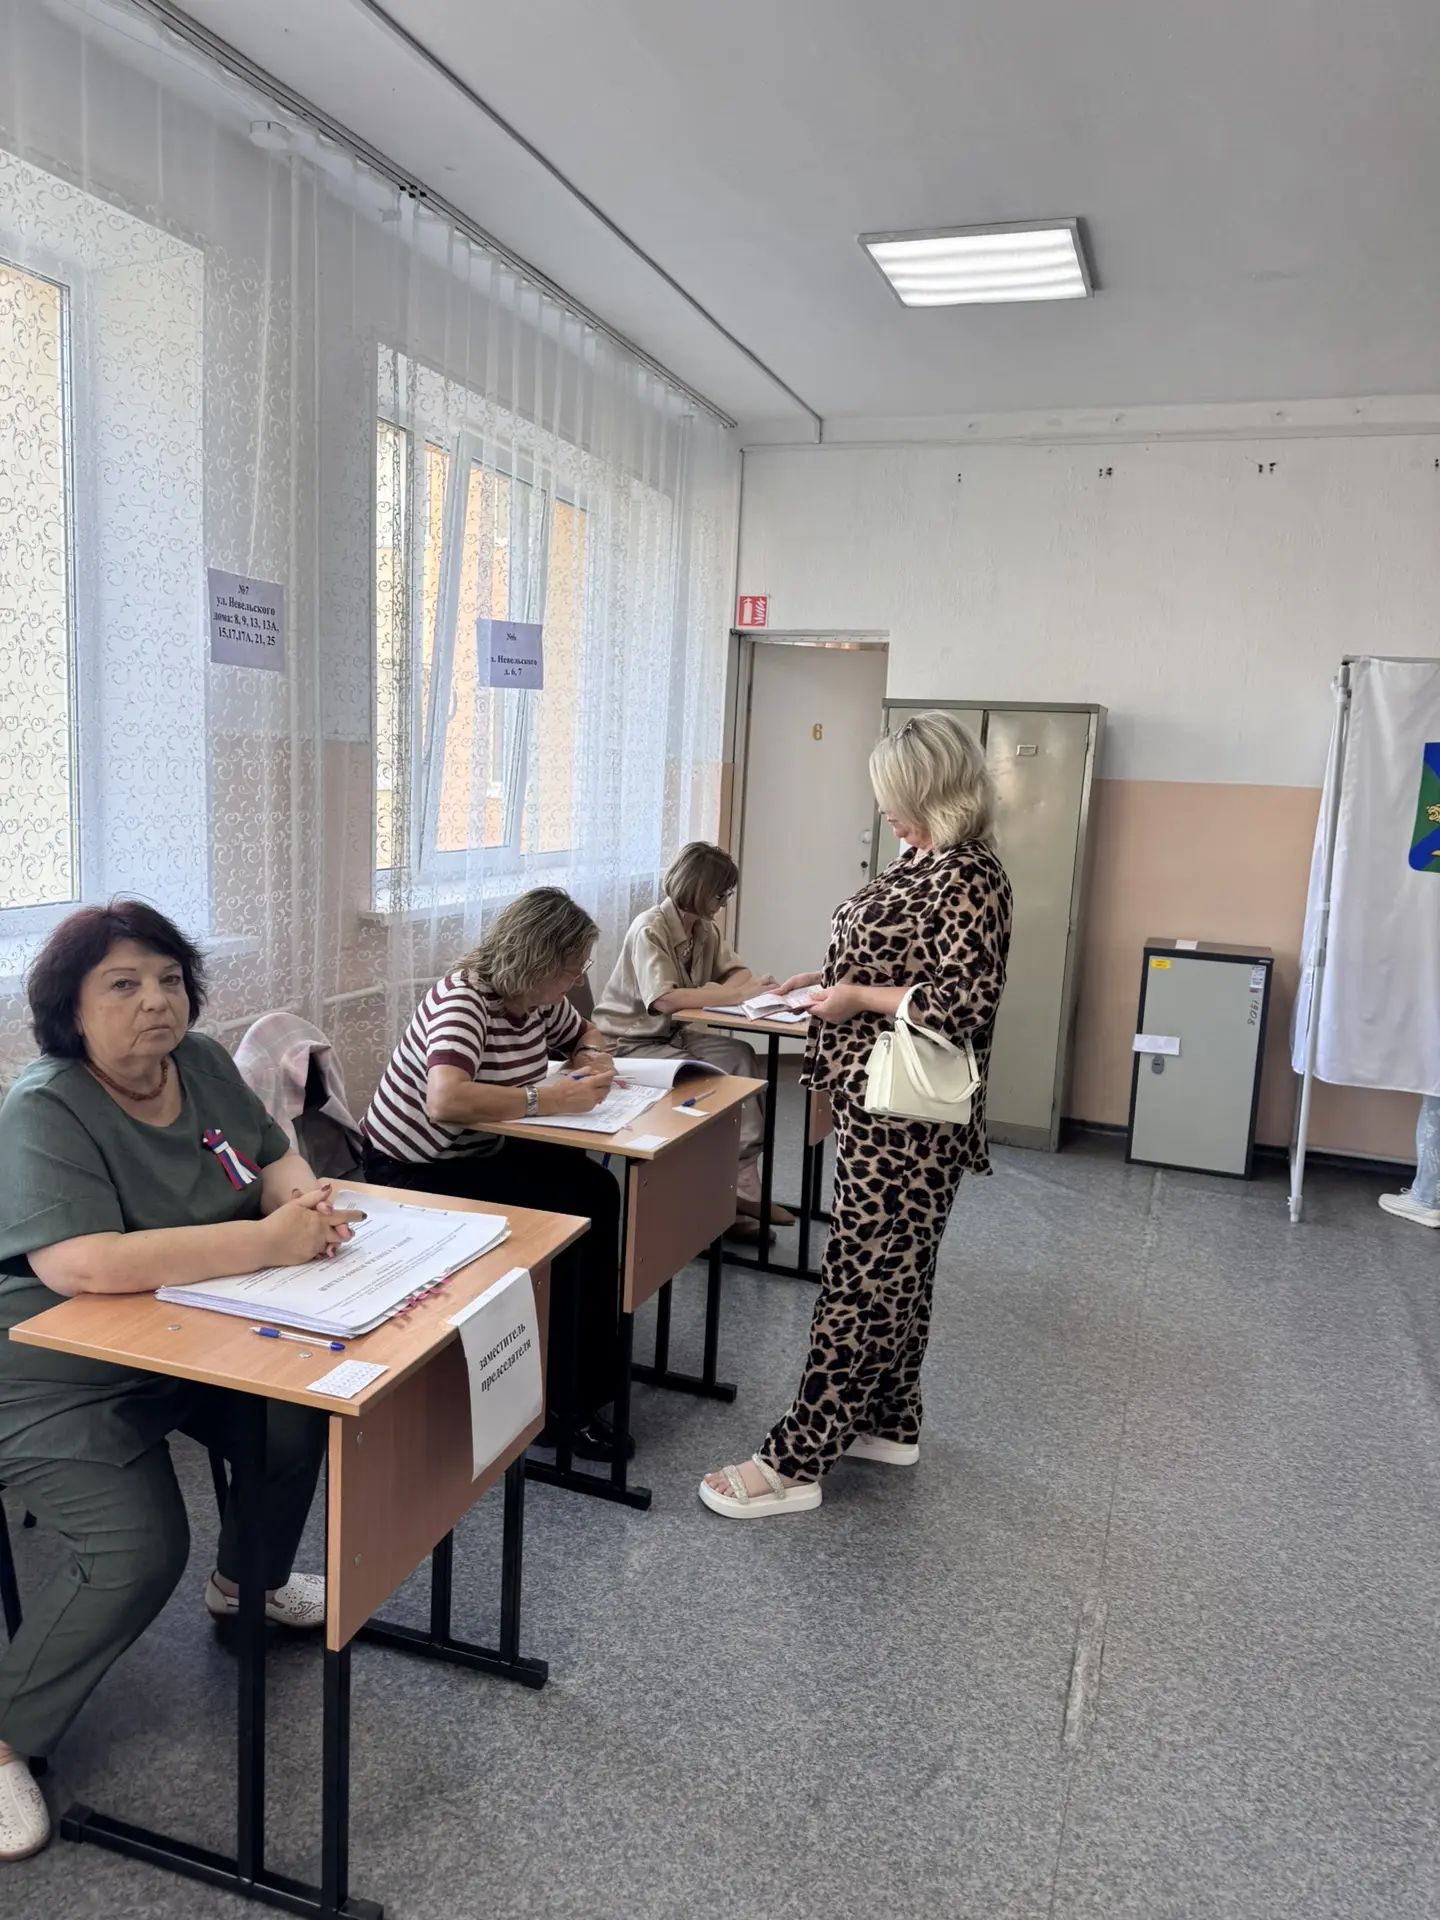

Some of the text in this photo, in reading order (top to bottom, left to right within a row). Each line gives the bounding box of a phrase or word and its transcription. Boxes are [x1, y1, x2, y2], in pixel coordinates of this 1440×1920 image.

[238, 584, 249, 595] №7
[216, 596, 275, 616] ул. Невельского
[213, 612, 233, 623] дома:
[234, 614, 241, 625] 8,
[242, 615, 249, 627] 9,
[250, 617, 261, 629] 13,
[267, 635, 276, 646] 25
[518, 667, 522, 676] 7
[812, 723, 822, 741] 6
[479, 1322, 526, 1372] заместитель
[481, 1339, 531, 1392] председателя
